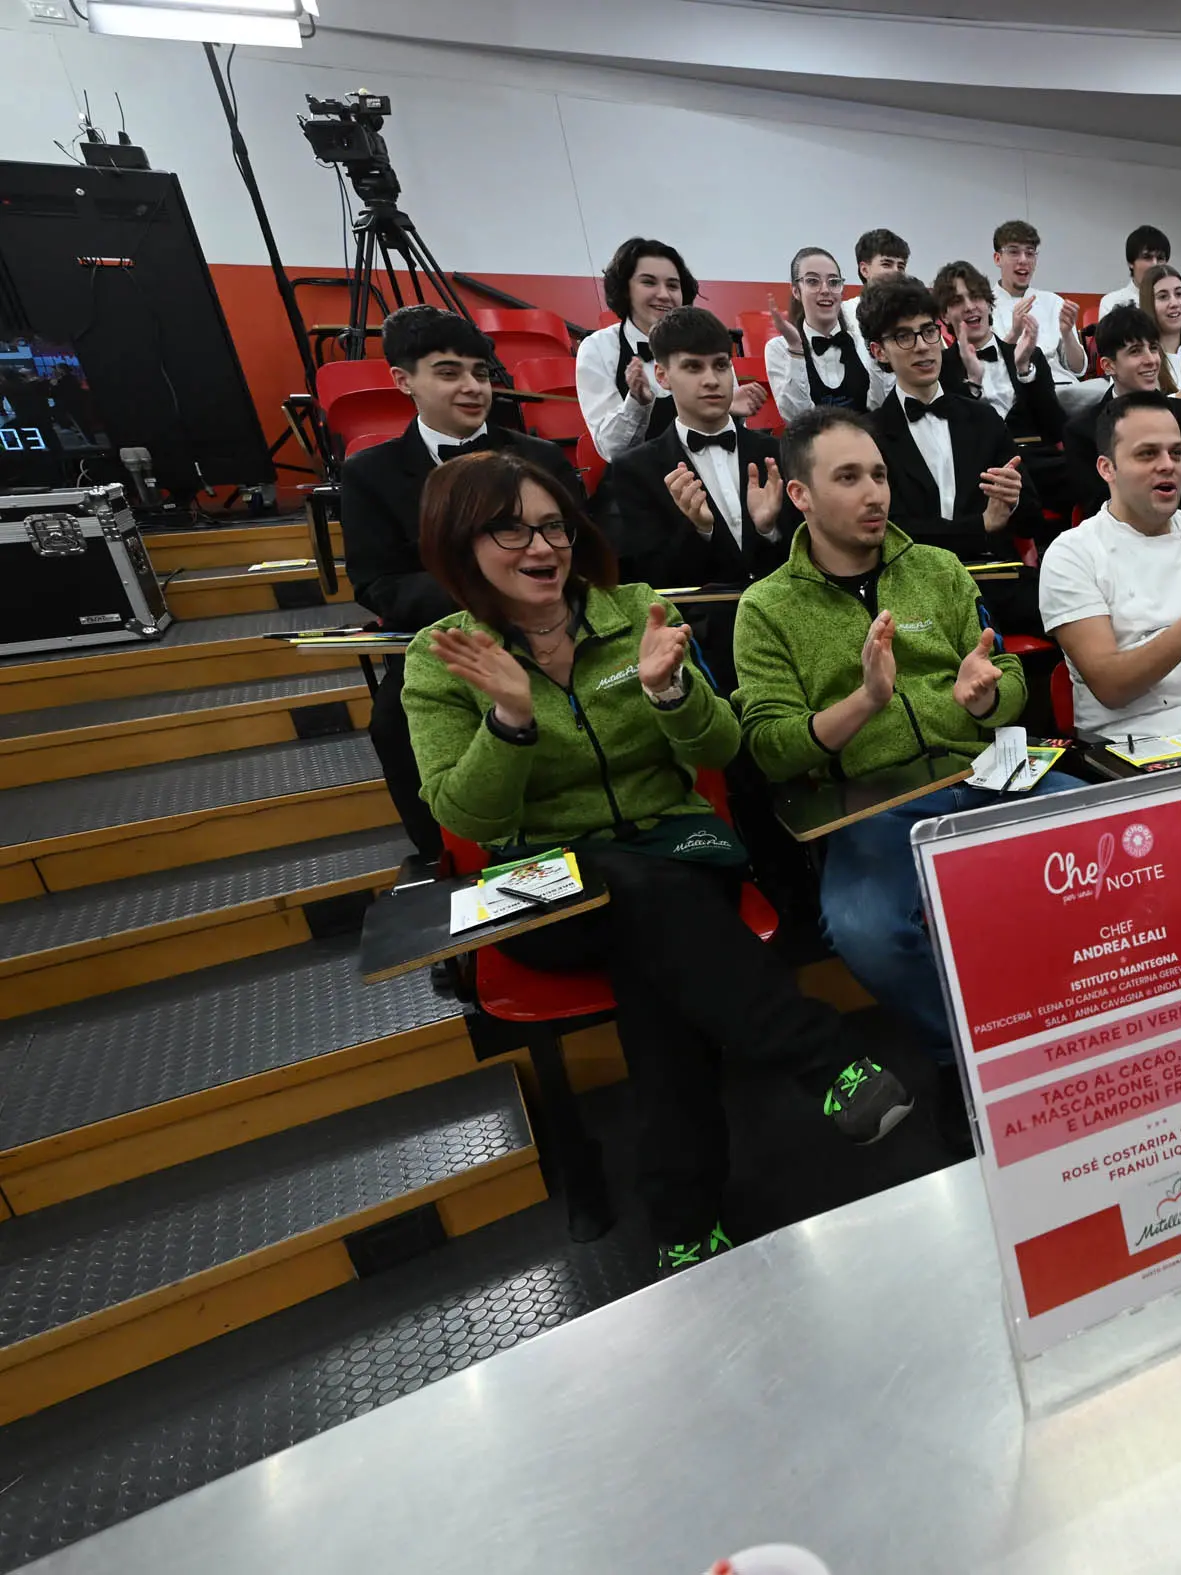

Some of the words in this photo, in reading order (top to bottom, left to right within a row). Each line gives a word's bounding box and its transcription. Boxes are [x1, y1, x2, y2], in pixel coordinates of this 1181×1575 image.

[1044, 832, 1115, 900] Chef
[1106, 864, 1165, 892] NOTTE
[1073, 936, 1131, 964] ANDREA
[1132, 926, 1167, 947] LEALI
[1099, 919, 1134, 939] CHEF
[1070, 970, 1119, 991] ISTITUTO
[1120, 952, 1179, 977] MANTEGNA
[974, 1011, 1032, 1035] PASTICCERIA
[1038, 1001, 1064, 1016] ELENA
[1065, 998, 1075, 1008] DI
[1075, 987, 1109, 1005] CANDIA
[1118, 973, 1158, 991] CATERINA
[1045, 1014, 1068, 1028] SALA
[1074, 1004, 1100, 1019] ANNA
[1101, 990, 1144, 1009] CAVAGNA
[1153, 980, 1177, 994] LINDA
[1044, 1027, 1122, 1061] TARTARE
[1126, 1020, 1143, 1036] DI
[1041, 1080, 1088, 1105] TACO
[1094, 1072, 1115, 1089] AL
[1119, 1050, 1181, 1079] CACAO,
[1005, 1119, 1027, 1137] AL
[1032, 1074, 1158, 1127] MASCARPONE,
[1066, 1118, 1078, 1133] E
[1083, 1089, 1160, 1127] LAMPONI
[1062, 1157, 1099, 1183] ROSÉ
[1103, 1131, 1178, 1166] COSTARIPA
